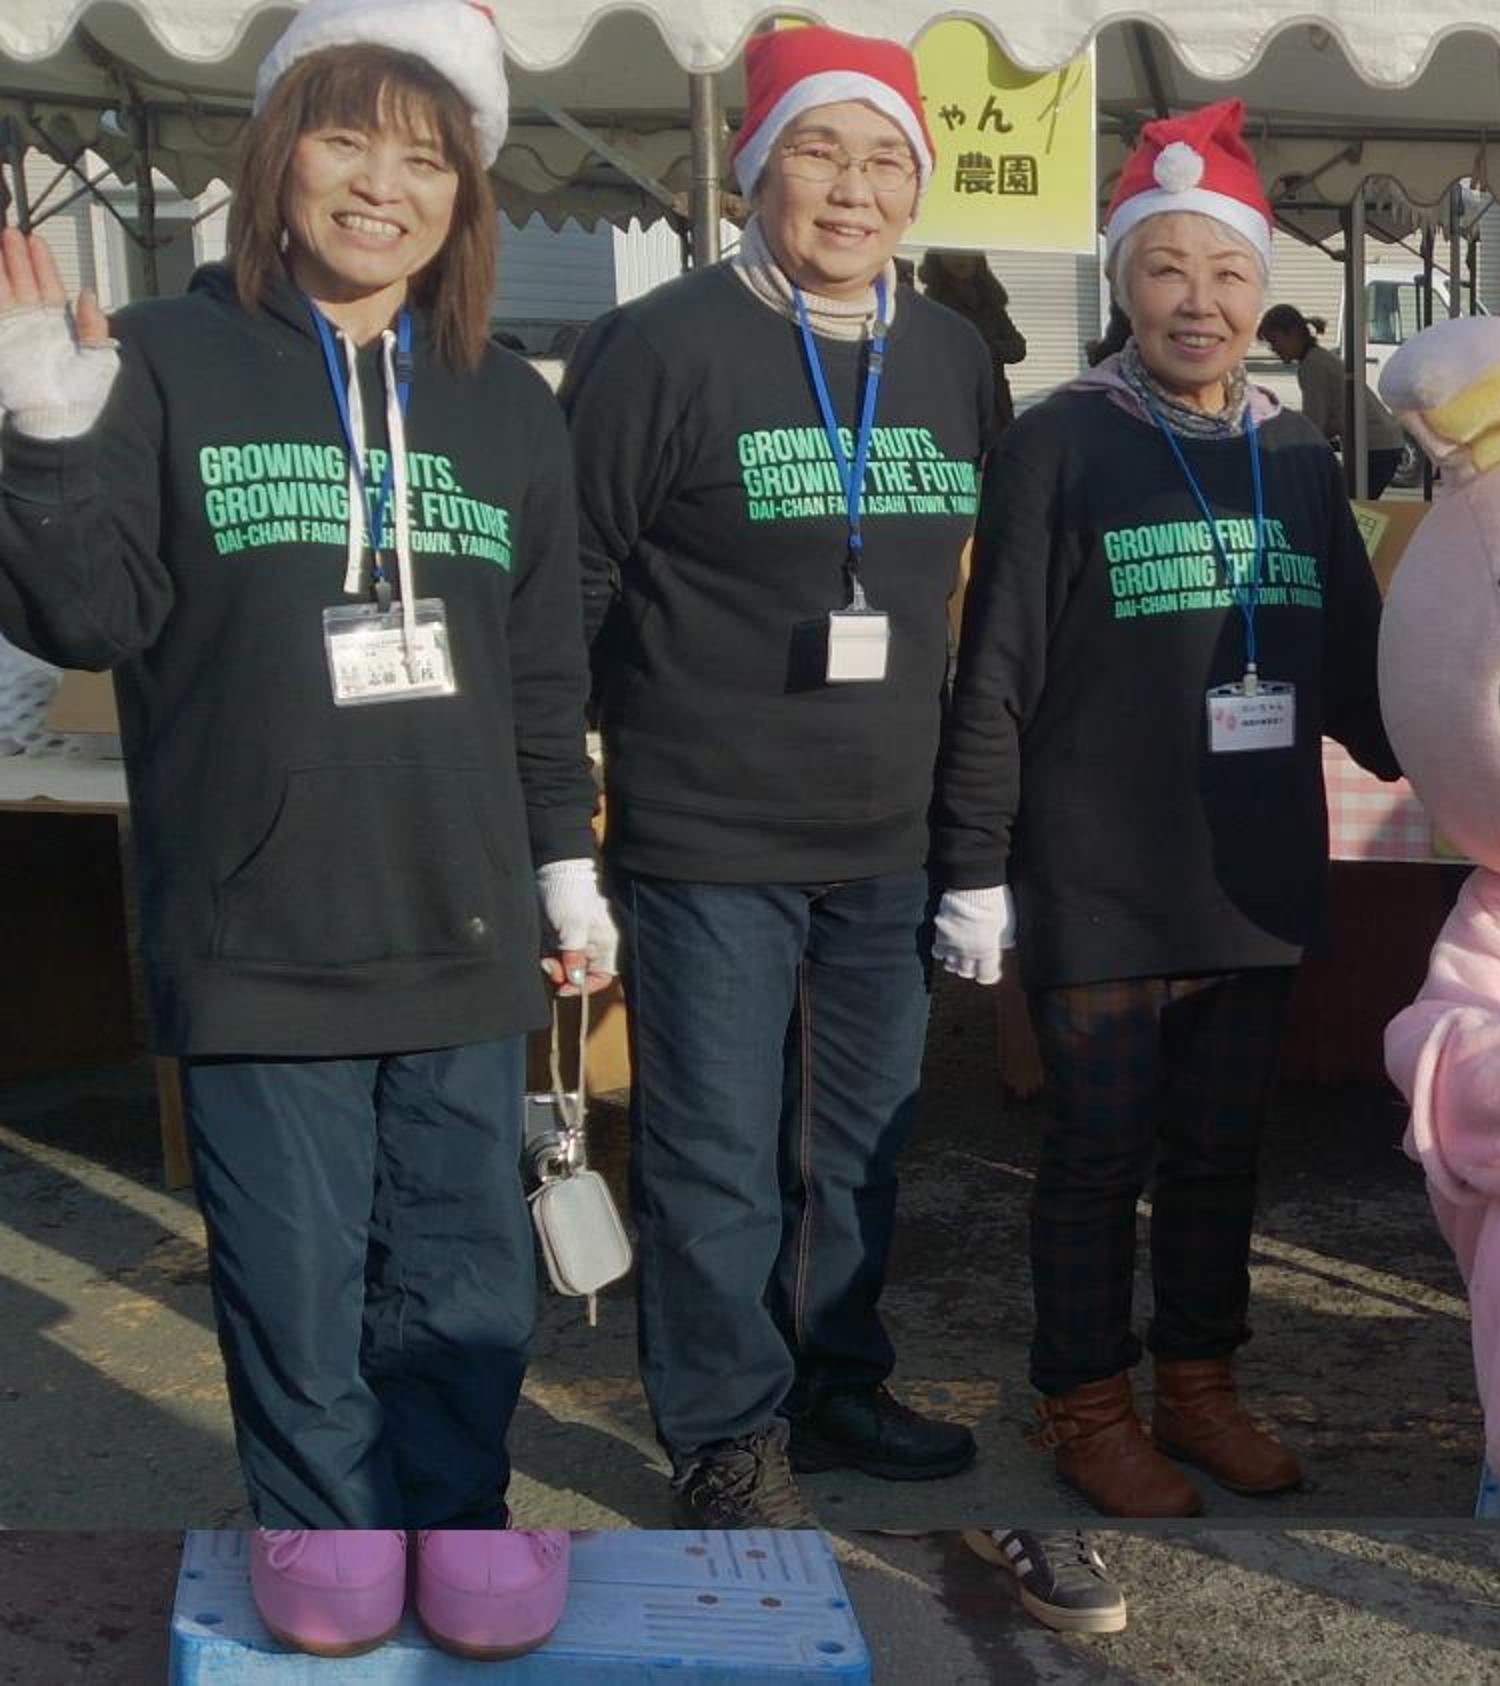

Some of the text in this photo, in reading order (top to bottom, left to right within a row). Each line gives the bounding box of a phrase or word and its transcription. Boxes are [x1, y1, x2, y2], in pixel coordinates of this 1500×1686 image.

[953, 151, 1039, 196] 農園
[199, 442, 463, 494] GROWING RITS.
[738, 427, 945, 467] GROWIG RUITS.
[743, 461, 866, 498] GROWI
[865, 461, 917, 493] THE
[205, 481, 350, 529] GROWING
[421, 490, 512, 548] FUTURE.
[749, 496, 827, 521] DAI-CHAN
[868, 495, 908, 514] ASAHI
[214, 520, 298, 556] DAI-CHAN
[300, 519, 348, 546] FARM
[408, 530, 457, 557] OWN,
[1103, 518, 1292, 564] GROWING FRUTS.
[1109, 554, 1218, 599] GROWING
